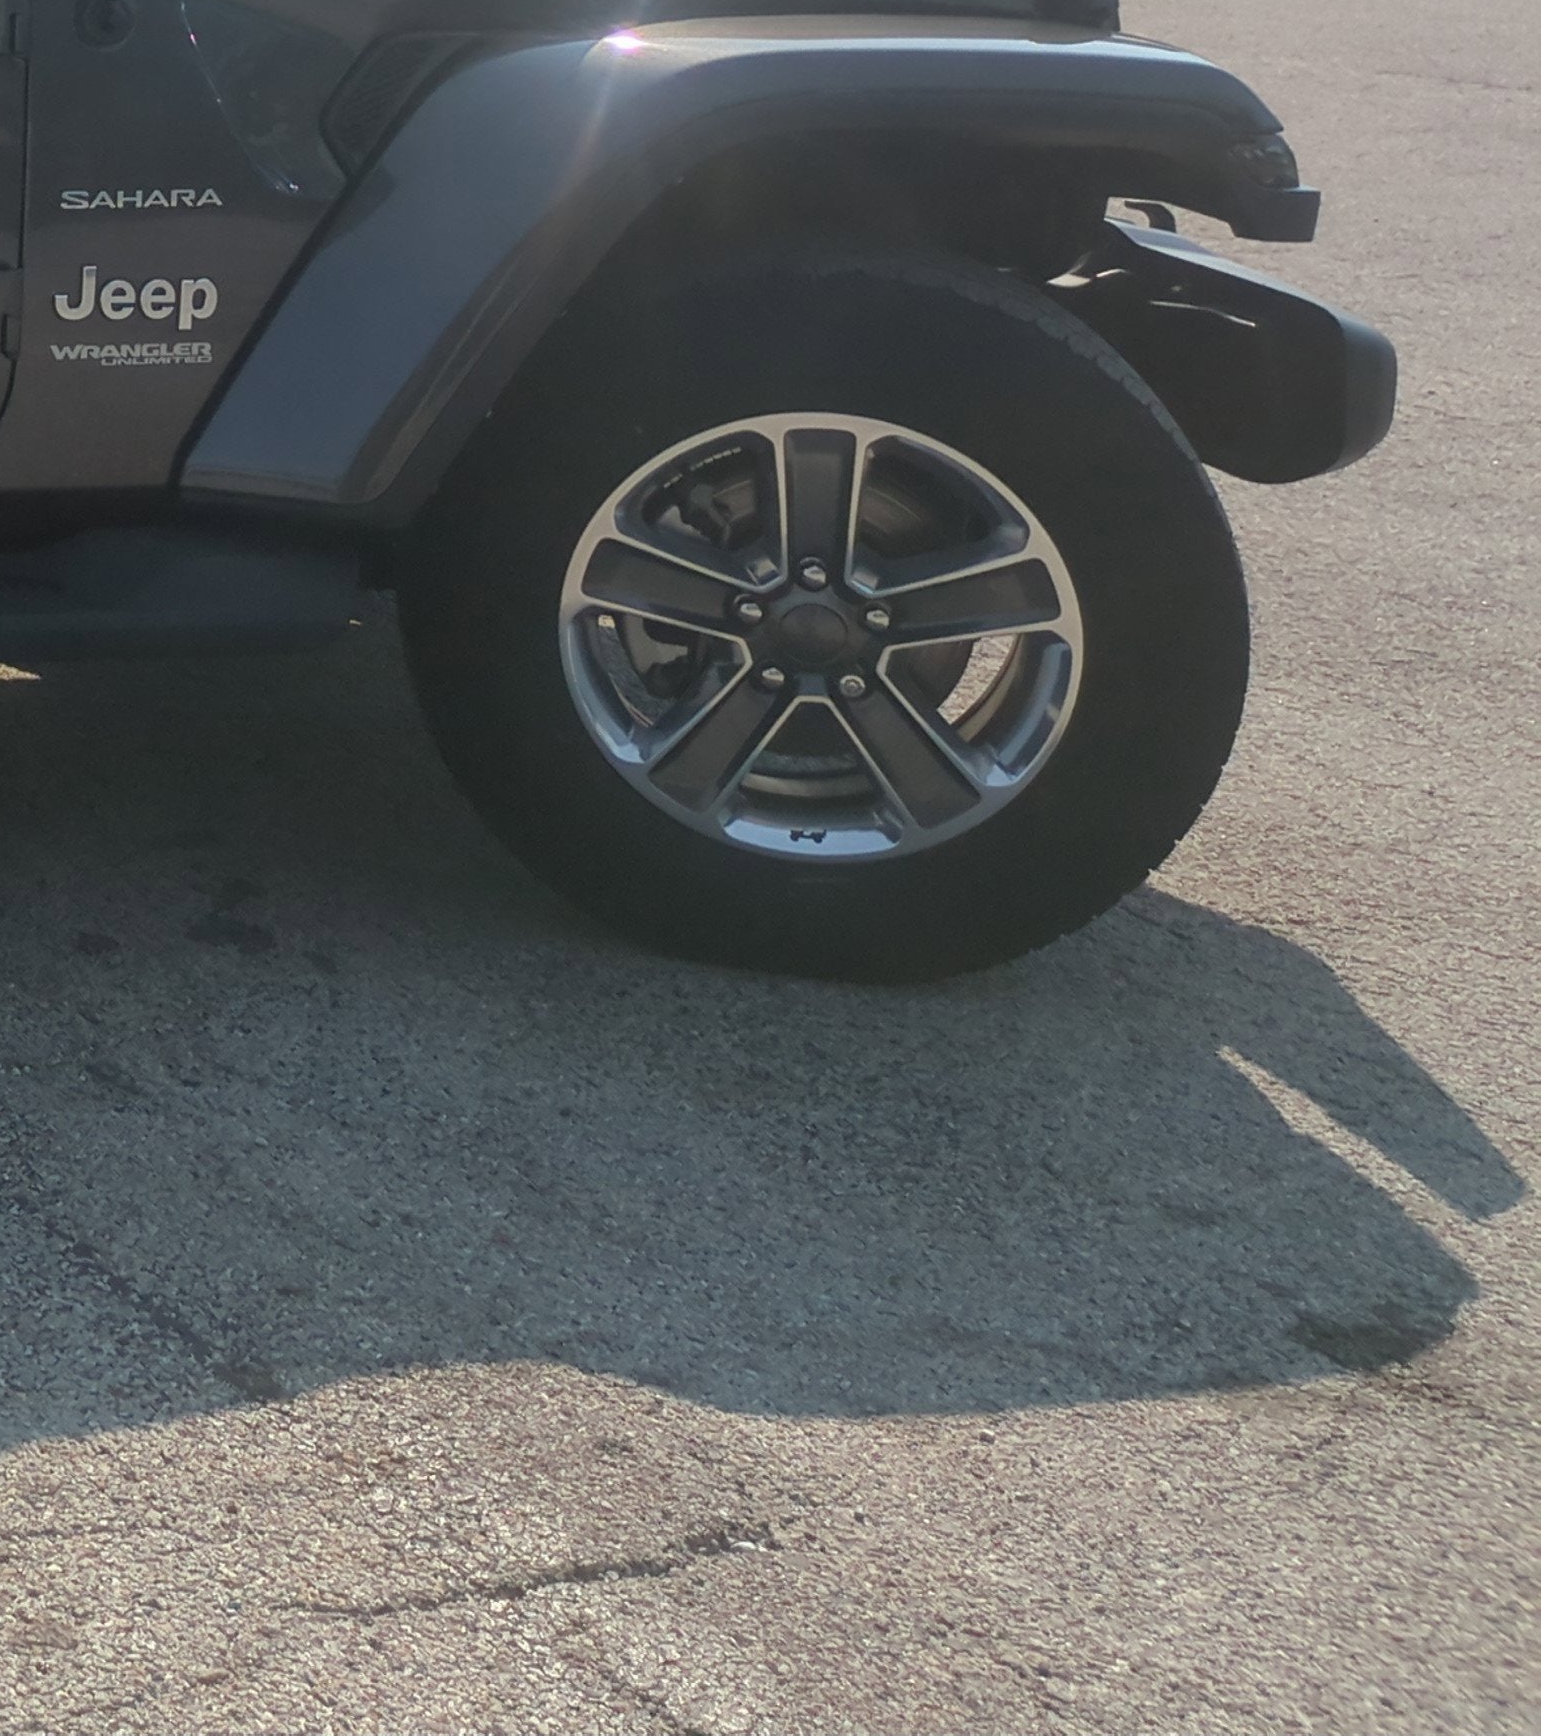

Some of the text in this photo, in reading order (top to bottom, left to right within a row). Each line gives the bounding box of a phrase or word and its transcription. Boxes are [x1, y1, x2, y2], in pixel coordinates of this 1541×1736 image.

[59, 188, 223, 210] SAHARA
[54, 265, 218, 331] Jeep
[50, 342, 213, 361] WRANGLER
[100, 356, 213, 367] UNLIMITED
